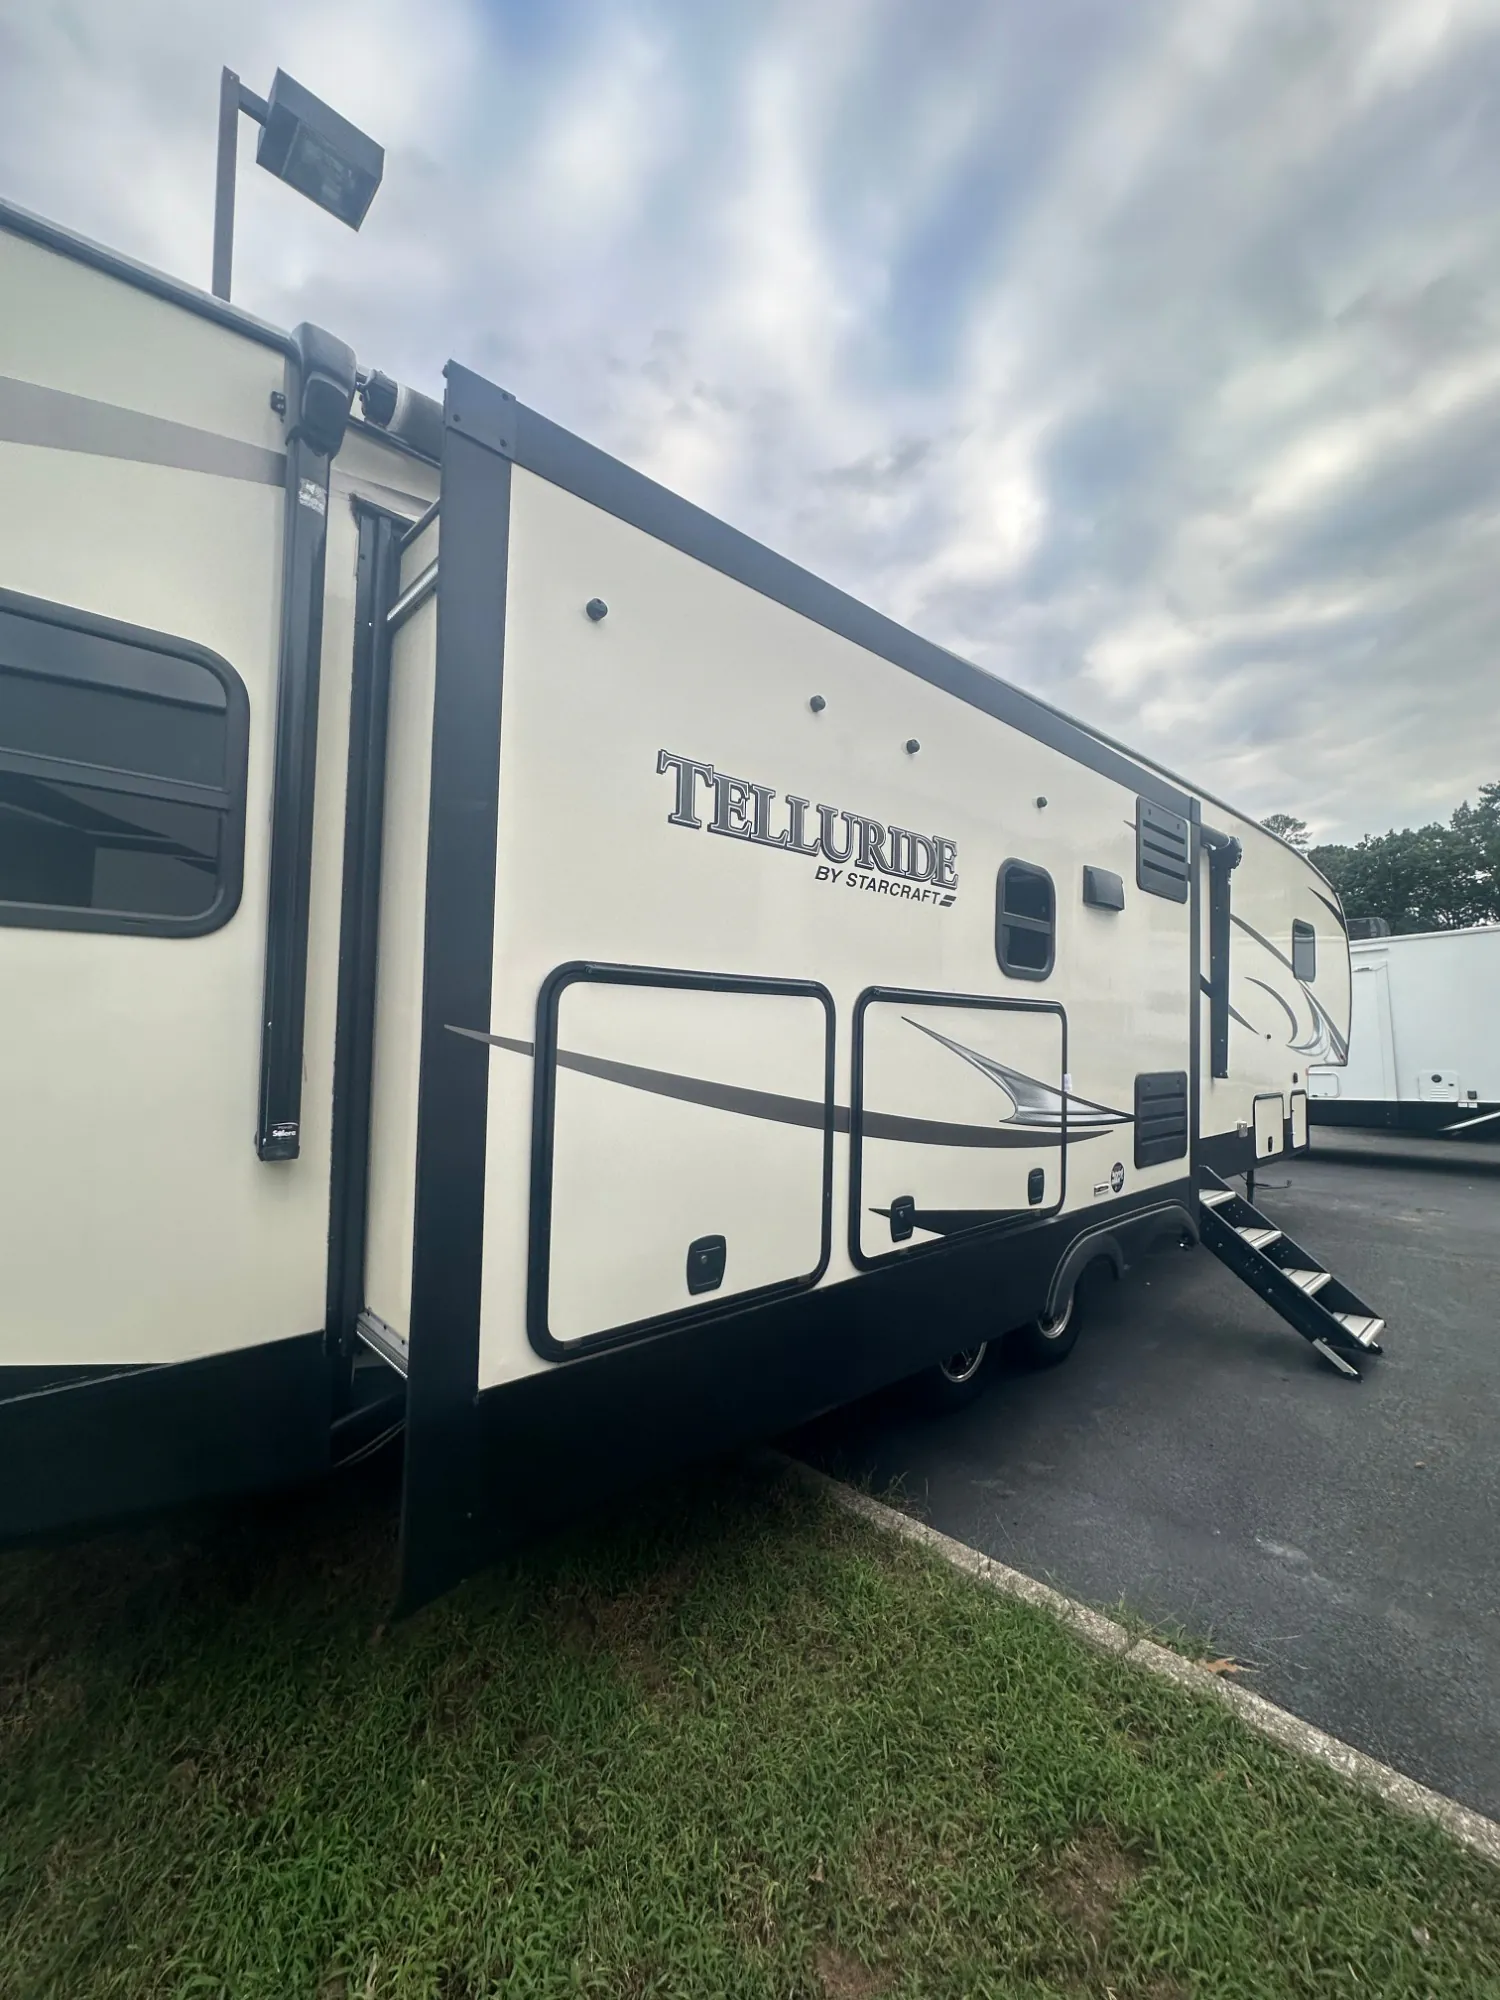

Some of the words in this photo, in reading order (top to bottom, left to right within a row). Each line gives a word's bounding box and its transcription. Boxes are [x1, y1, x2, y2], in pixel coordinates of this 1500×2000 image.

[656, 749, 958, 890] TELLURIDE
[815, 865, 843, 883] BY
[846, 872, 940, 905] STARCRAFT
